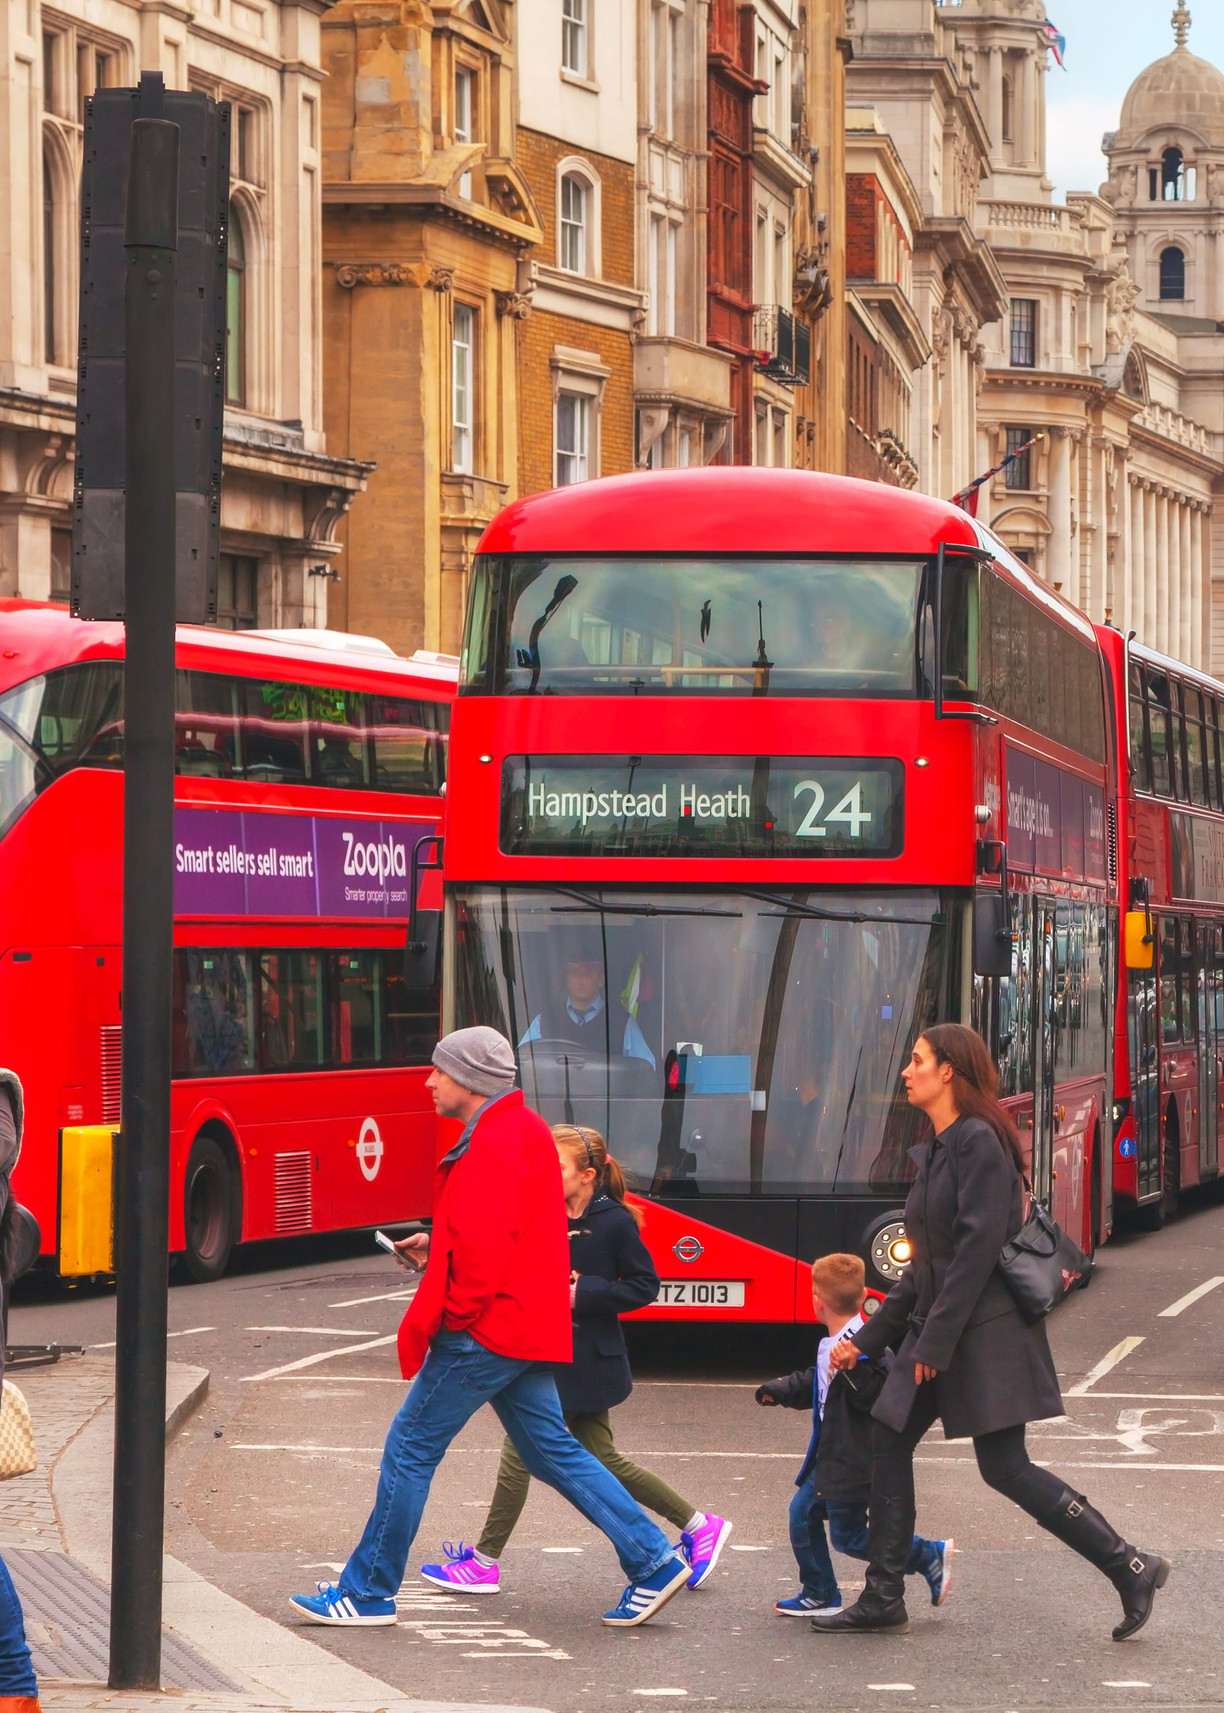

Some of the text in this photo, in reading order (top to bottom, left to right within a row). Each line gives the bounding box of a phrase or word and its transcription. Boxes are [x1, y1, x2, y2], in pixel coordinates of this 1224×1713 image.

[529, 779, 872, 837] Hampstead Heath 24
[175, 843, 314, 878] Smart sellers sell smart
[342, 832, 407, 886] Zoopla
[344, 886, 365, 902] Smarter
[390, 889, 408, 902] search
[656, 1285, 728, 1303] TZ 1013
